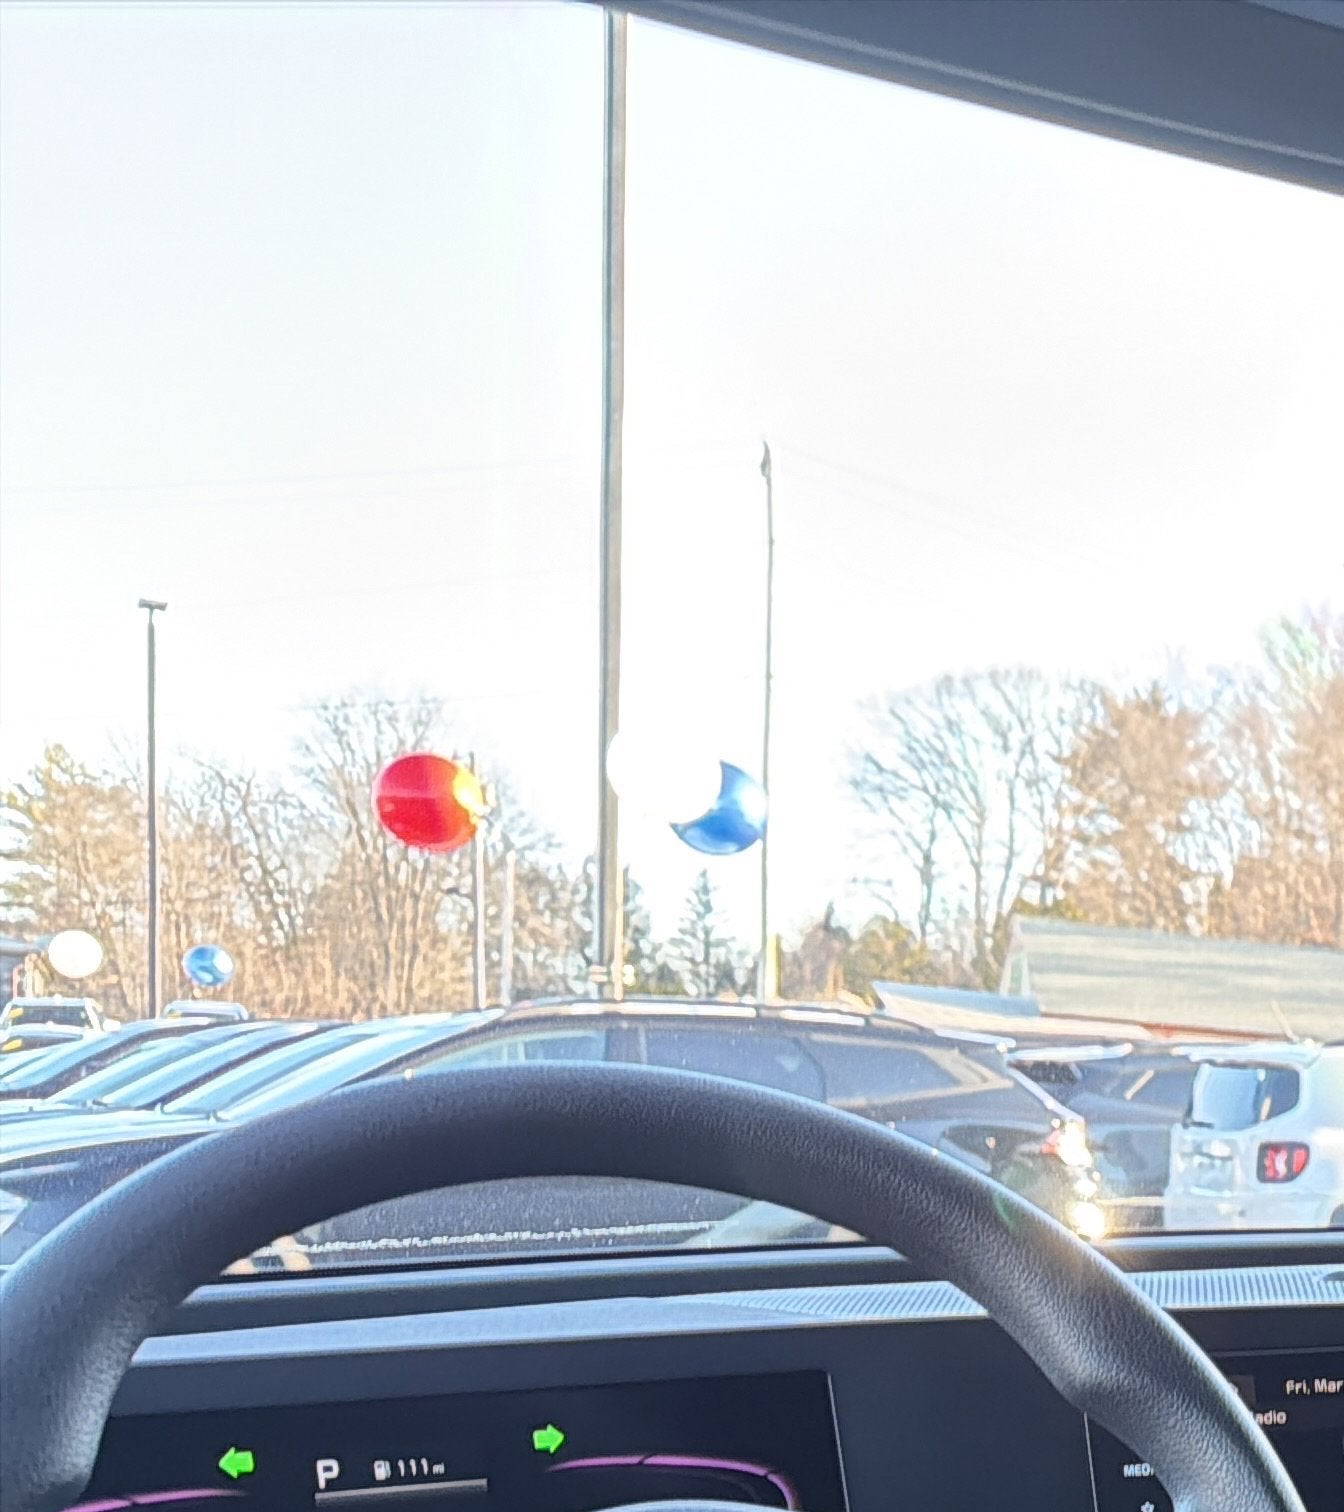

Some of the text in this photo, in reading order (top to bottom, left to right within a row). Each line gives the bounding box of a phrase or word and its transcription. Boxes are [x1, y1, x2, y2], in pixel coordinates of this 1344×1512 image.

[1251, 1409, 1288, 1426] adio
[315, 1458, 340, 1490] P
[397, 1456, 429, 1478] 111
